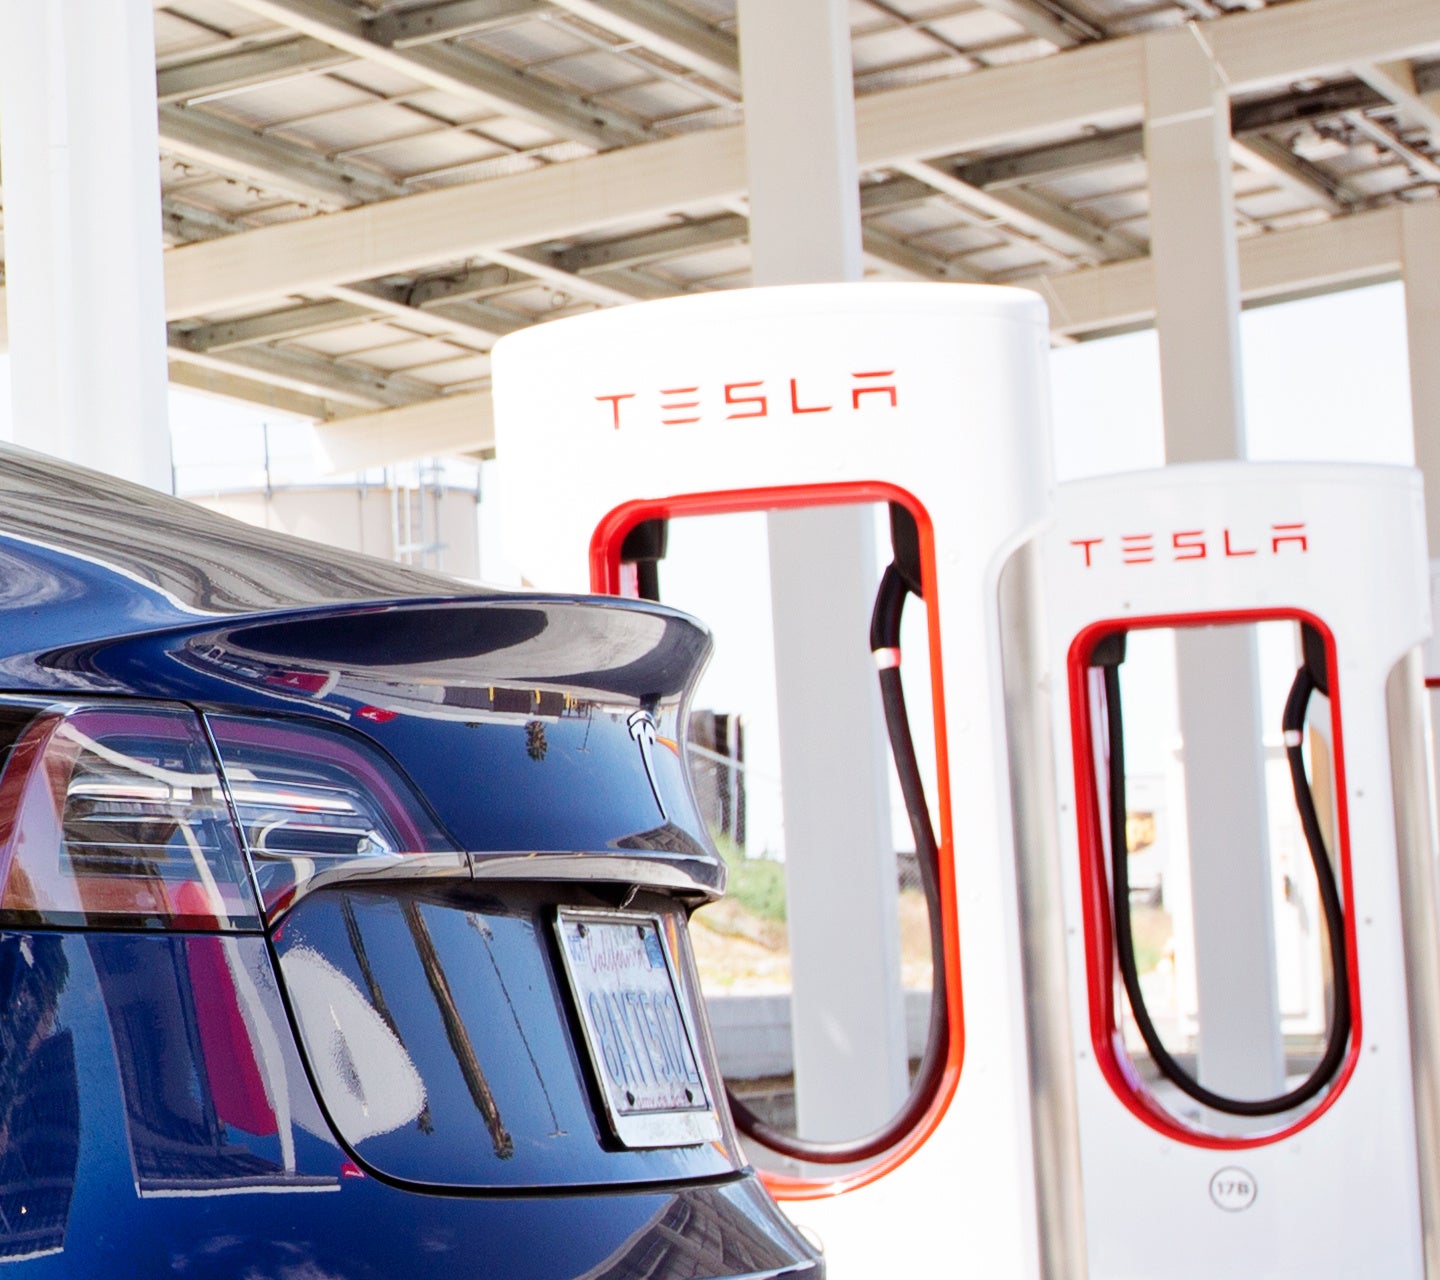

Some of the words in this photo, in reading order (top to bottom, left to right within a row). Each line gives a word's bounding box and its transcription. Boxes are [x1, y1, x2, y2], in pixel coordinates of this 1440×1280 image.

[594, 370, 897, 429] TESLA
[1070, 523, 1306, 567] TESLA
[1217, 1180, 1249, 1196] 17B
